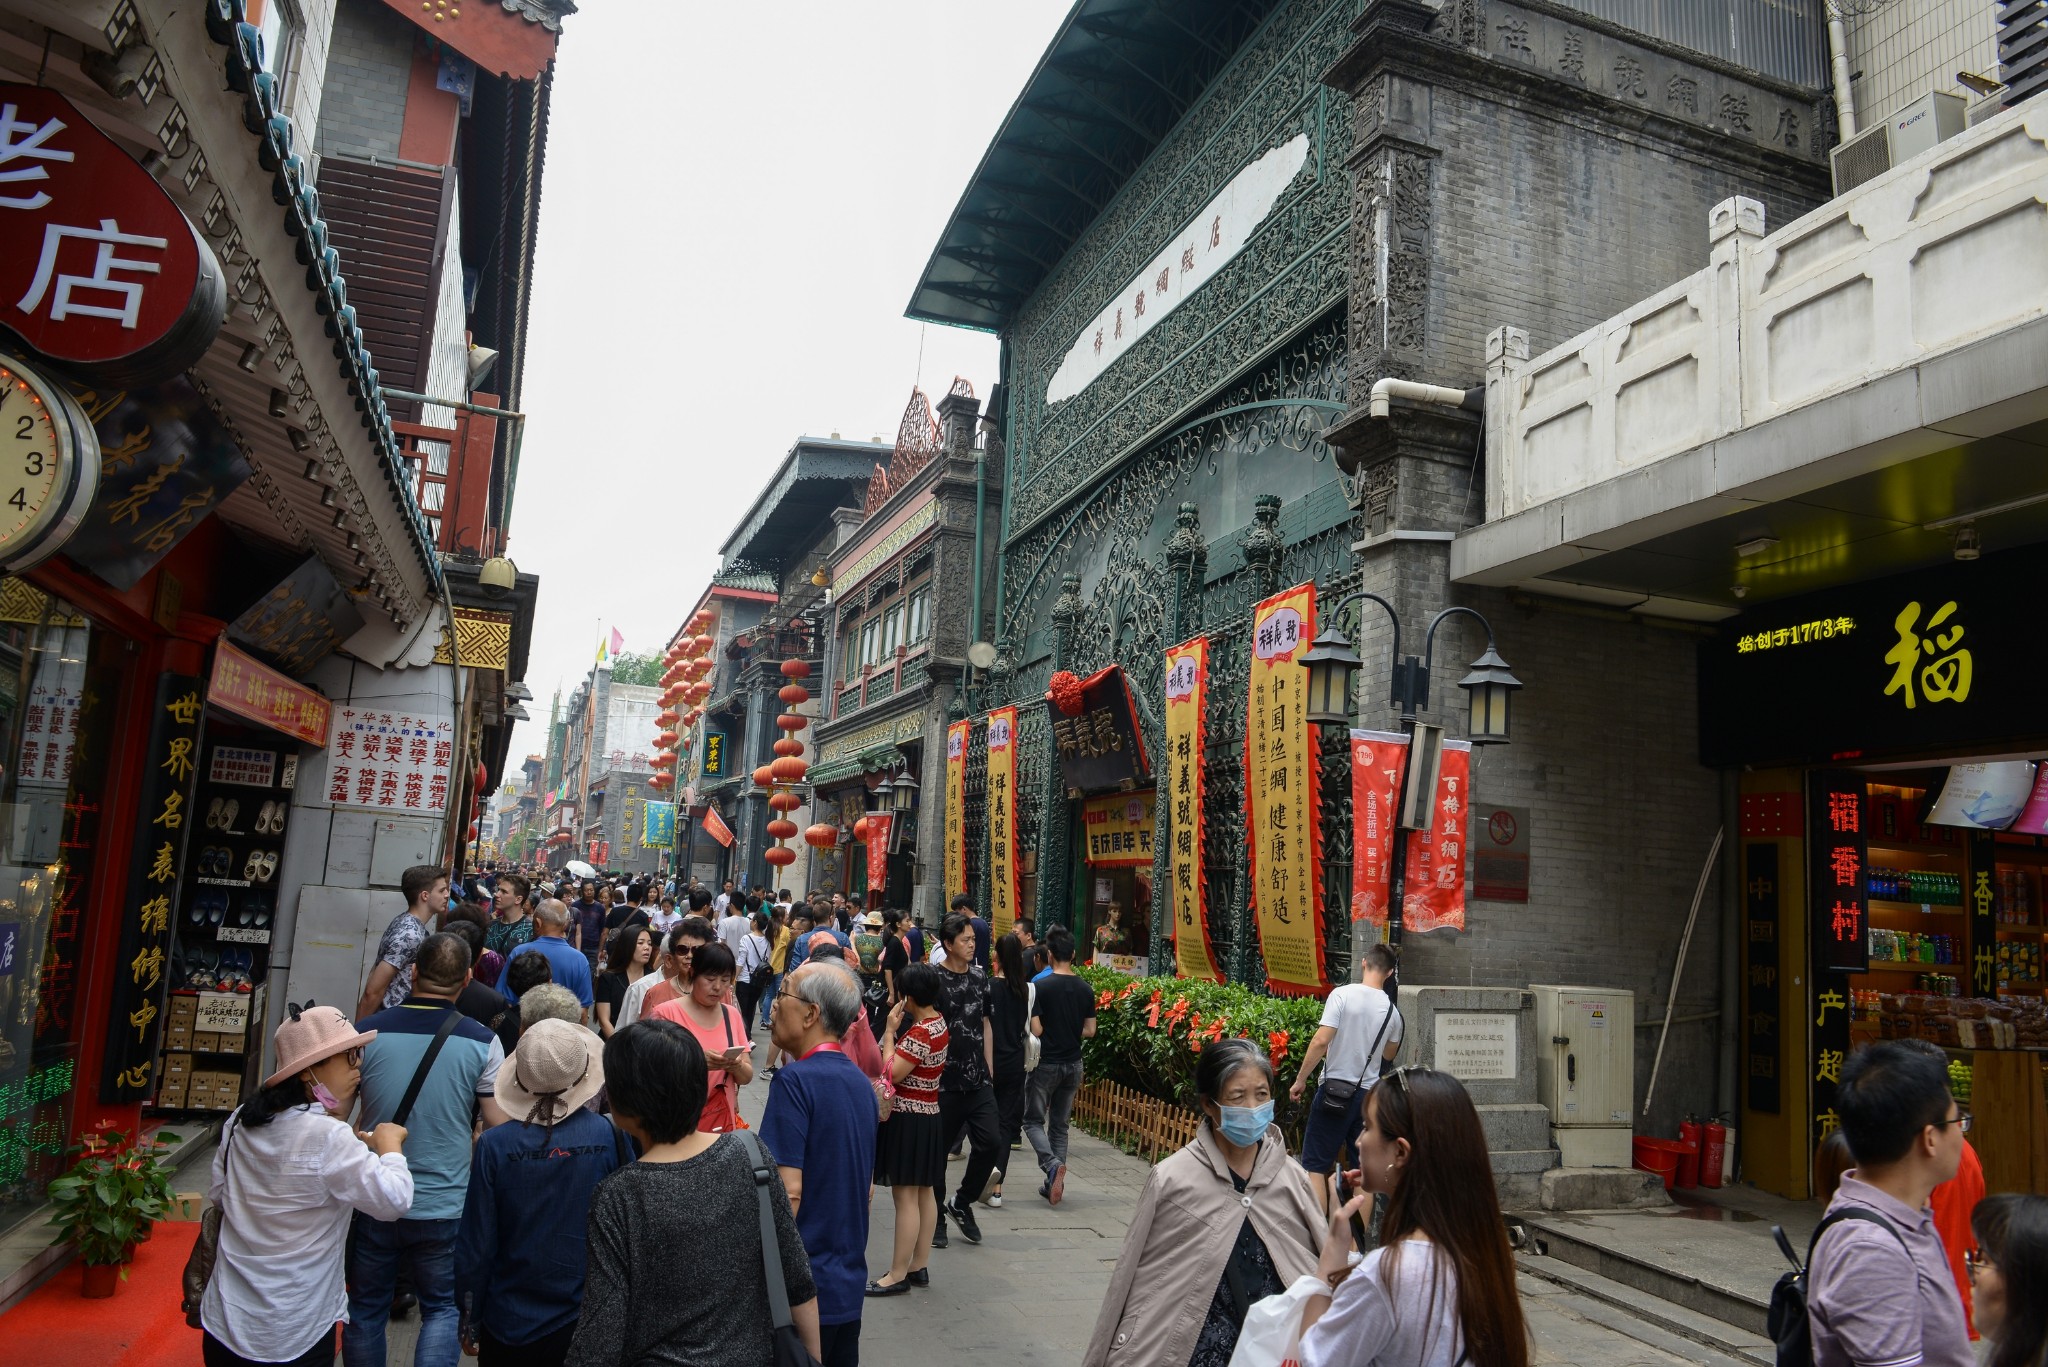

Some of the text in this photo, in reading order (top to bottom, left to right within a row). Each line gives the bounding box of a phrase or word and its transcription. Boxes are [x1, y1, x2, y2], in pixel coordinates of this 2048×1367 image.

[1905, 109, 1928, 127] GREE
[16, 416, 35, 440] 2
[25, 451, 44, 475] 3
[8, 487, 27, 511] 4
[1737, 616, 1856, 653] 始创于1773年
[1884, 600, 1973, 709] 稻
[342, 710, 452, 732] 中华筷子文化
[1356, 750, 1373, 760] 1796
[620, 786, 637, 857] 晋阳商务酒店
[1440, 776, 1460, 860] 百格丝绸
[1091, 832, 1135, 854] 店庆周年
[1366, 790, 1378, 883] 全场五折起 买一送一
[1829, 791, 1861, 942] 稻香村
[116, 691, 203, 1089] 世界名表维修中心
